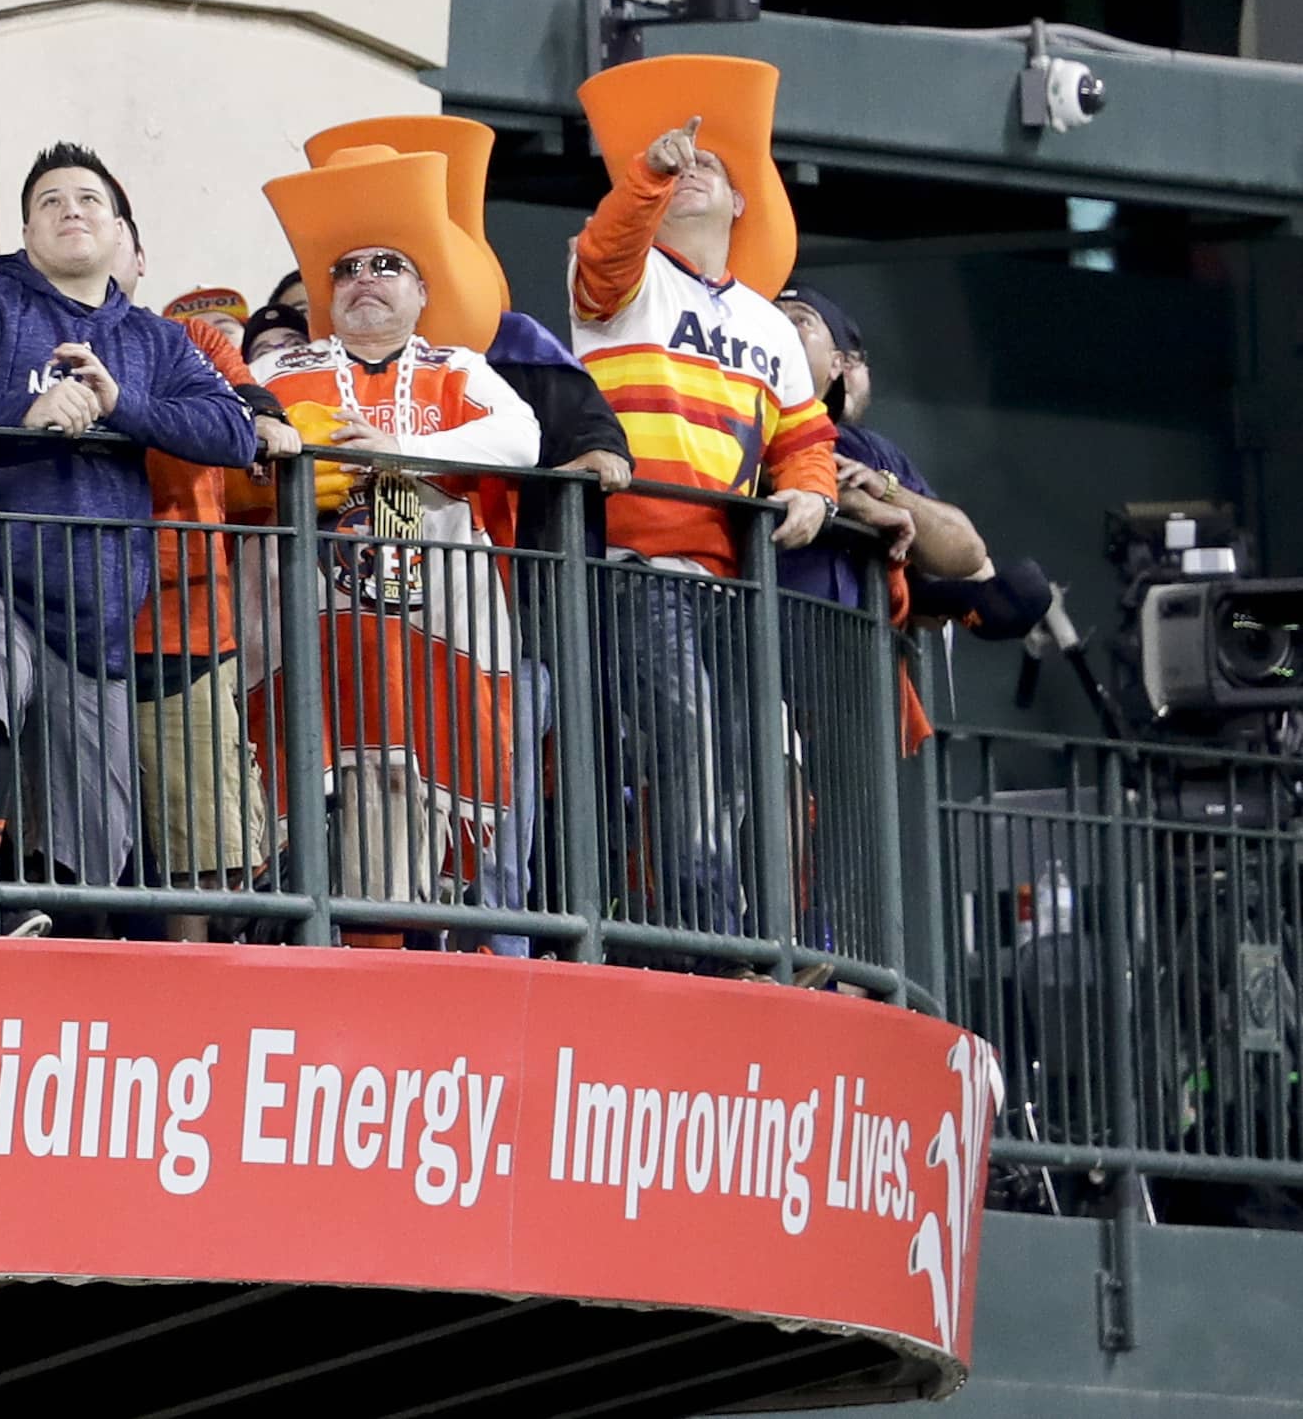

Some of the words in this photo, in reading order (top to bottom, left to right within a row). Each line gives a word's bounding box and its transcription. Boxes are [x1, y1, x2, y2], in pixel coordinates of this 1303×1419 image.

[668, 309, 781, 388] Atros
[241, 1027, 512, 1209] Energy.
[550, 1046, 821, 1236] Improving
[827, 1074, 917, 1223] Lives.
